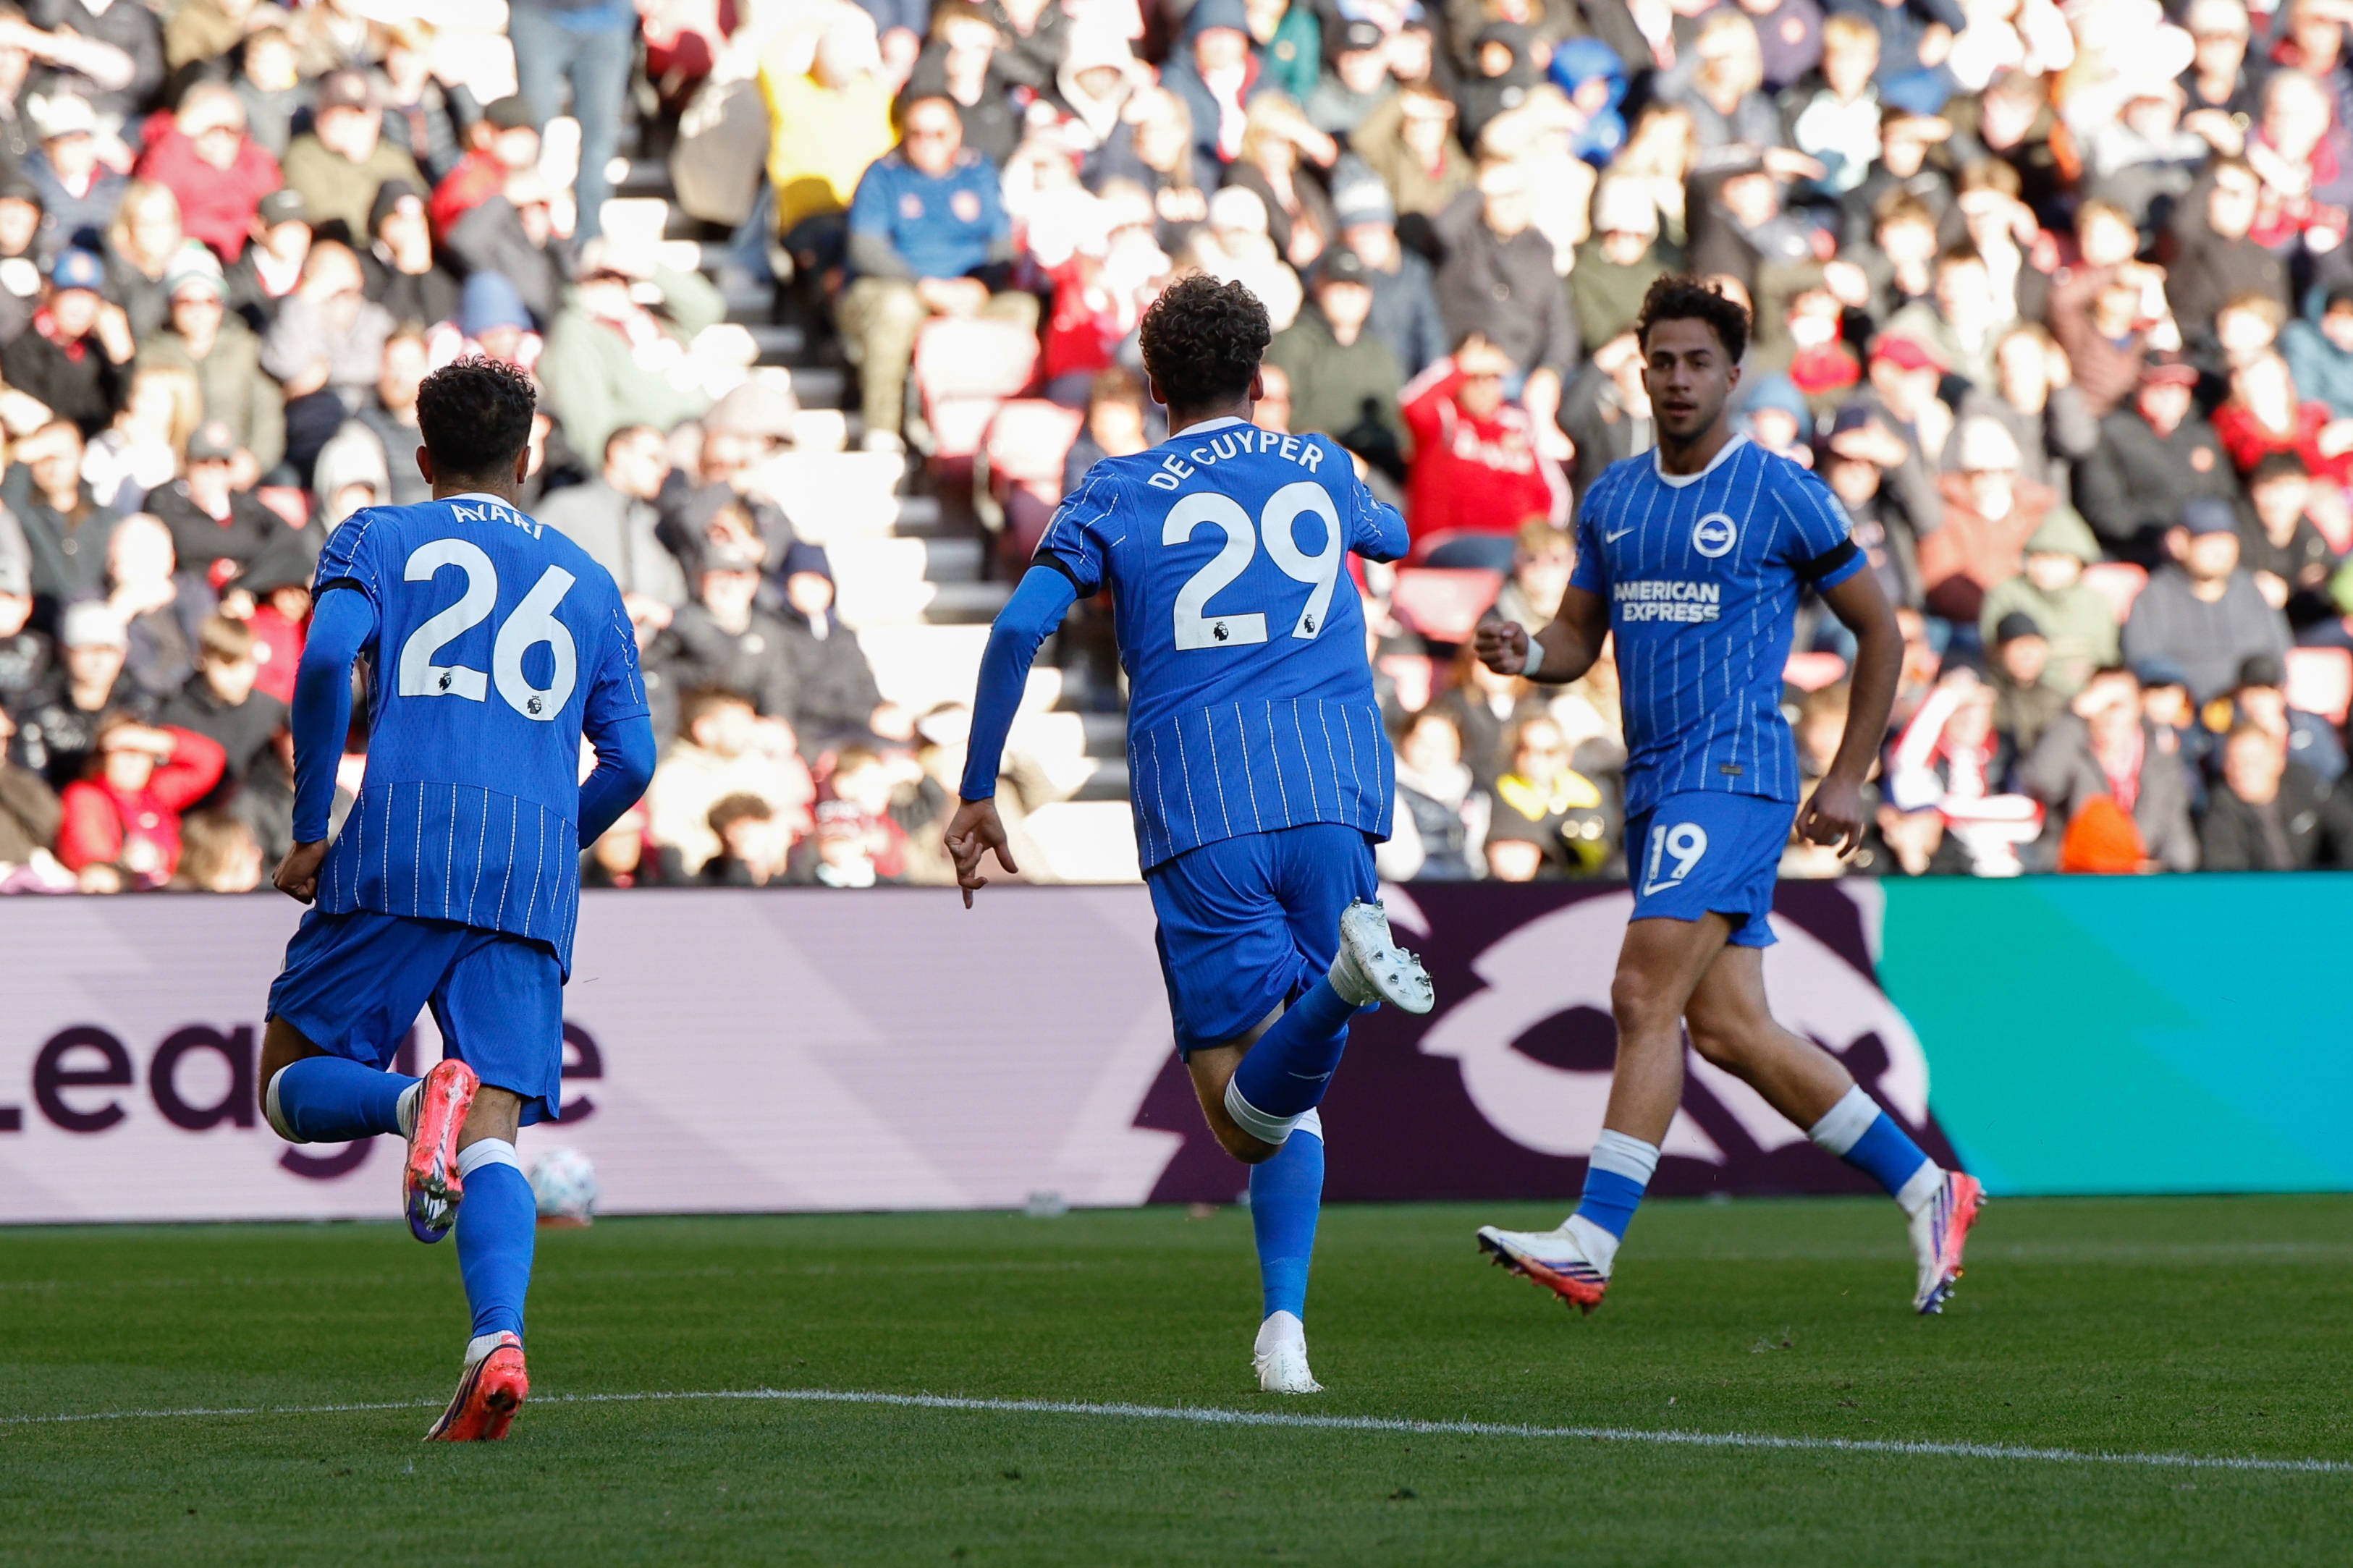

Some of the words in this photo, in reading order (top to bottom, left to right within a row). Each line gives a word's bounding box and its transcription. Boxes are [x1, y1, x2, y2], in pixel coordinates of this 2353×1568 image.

[1146, 454, 1196, 491] DE
[1189, 430, 1325, 474] CUYPER
[450, 504, 543, 541] AYARI
[1162, 480, 1342, 651] 29
[1613, 580, 1720, 603] AMERICAN
[399, 538, 578, 721] 26
[1622, 601, 1721, 624] EXPRESS
[1648, 821, 1708, 880] 19
